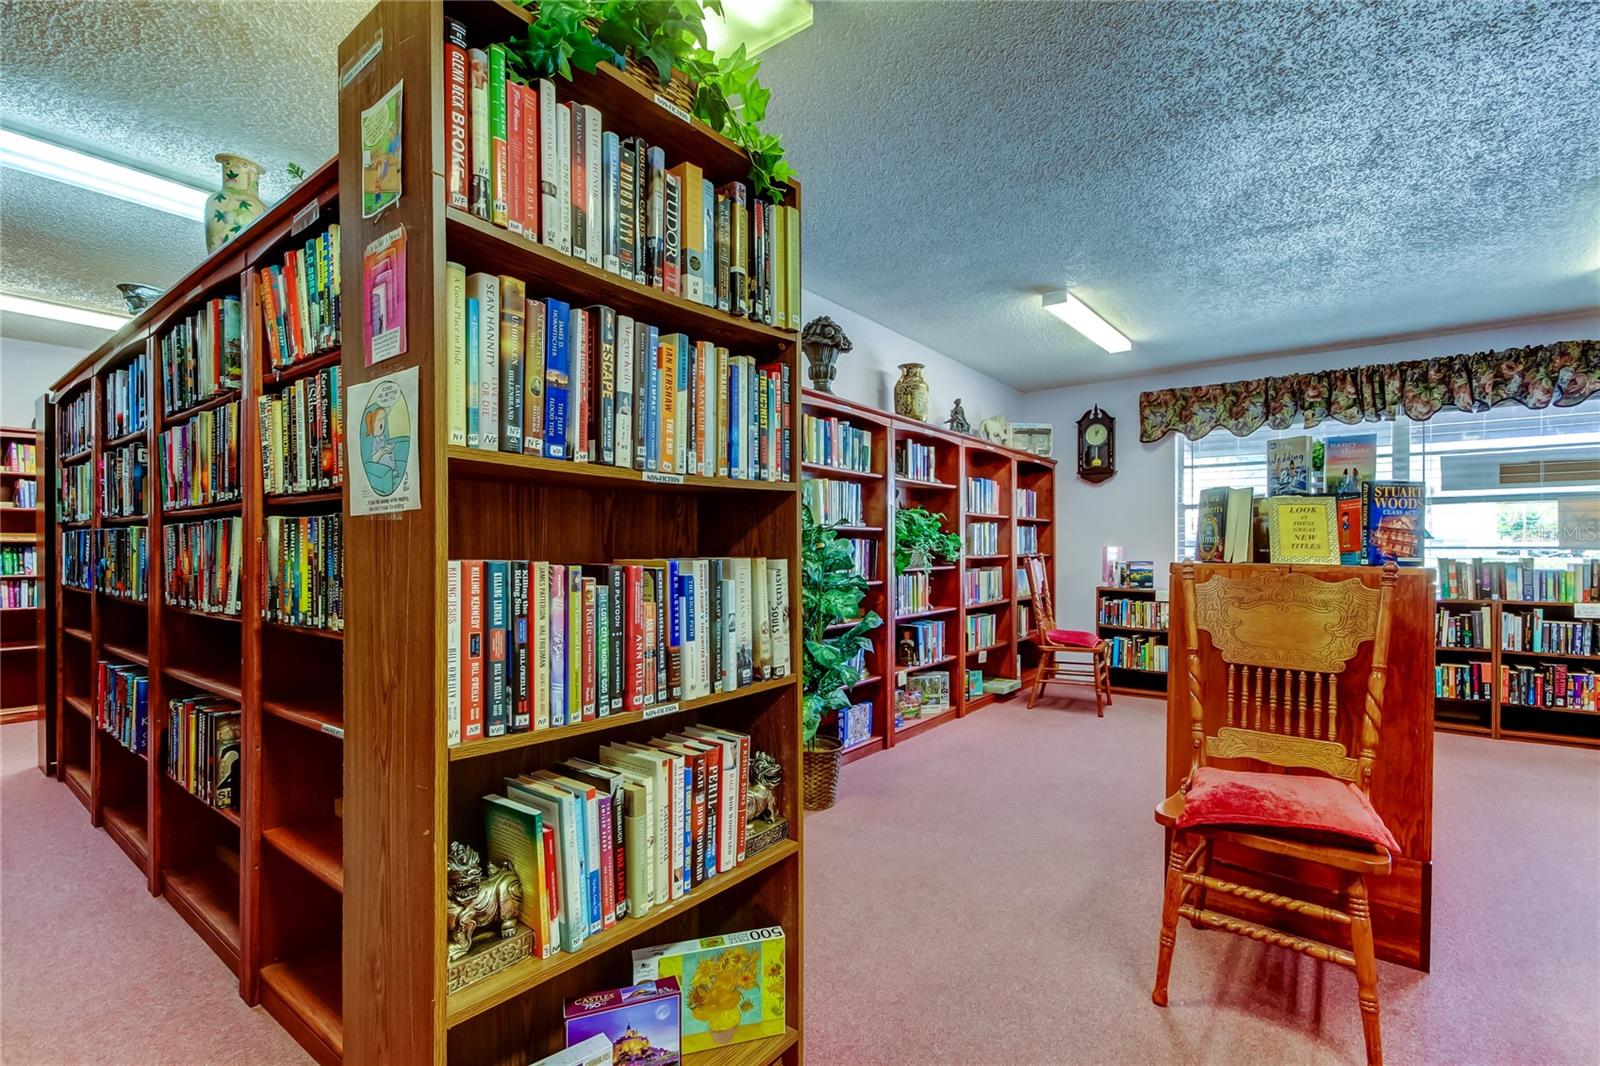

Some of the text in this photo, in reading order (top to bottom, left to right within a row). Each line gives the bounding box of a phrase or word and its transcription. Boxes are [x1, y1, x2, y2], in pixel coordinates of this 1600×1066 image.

[451, 51, 465, 178] GLENN BECK BROKE
[620, 162, 633, 244] DODGE CITY
[666, 188, 678, 258] TUDOR
[486, 283, 495, 368] SEAN HANNITY
[454, 346, 462, 366] Hide
[602, 343, 612, 400] ESCAPE
[482, 382, 489, 397] OR
[639, 386, 644, 396] 56
[261, 416, 269, 441] Sandford
[1268, 454, 1304, 466] Wedding
[647, 474, 681, 483] NON-FICTION
[1374, 486, 1423, 509] STUART WOODS
[448, 567, 457, 624] KILLING JESUS
[470, 567, 480, 628] KILLING KENNEDY
[493, 572, 502, 625] KILLING LINCOLN
[448, 648, 456, 698] BILL O'REILLY
[471, 677, 479, 702] O'REILLY
[645, 705, 677, 716] NON-FICTION
[708, 765, 718, 809] PERIL
[750, 926, 783, 940] 500
[574, 993, 615, 1005] CASTLES
